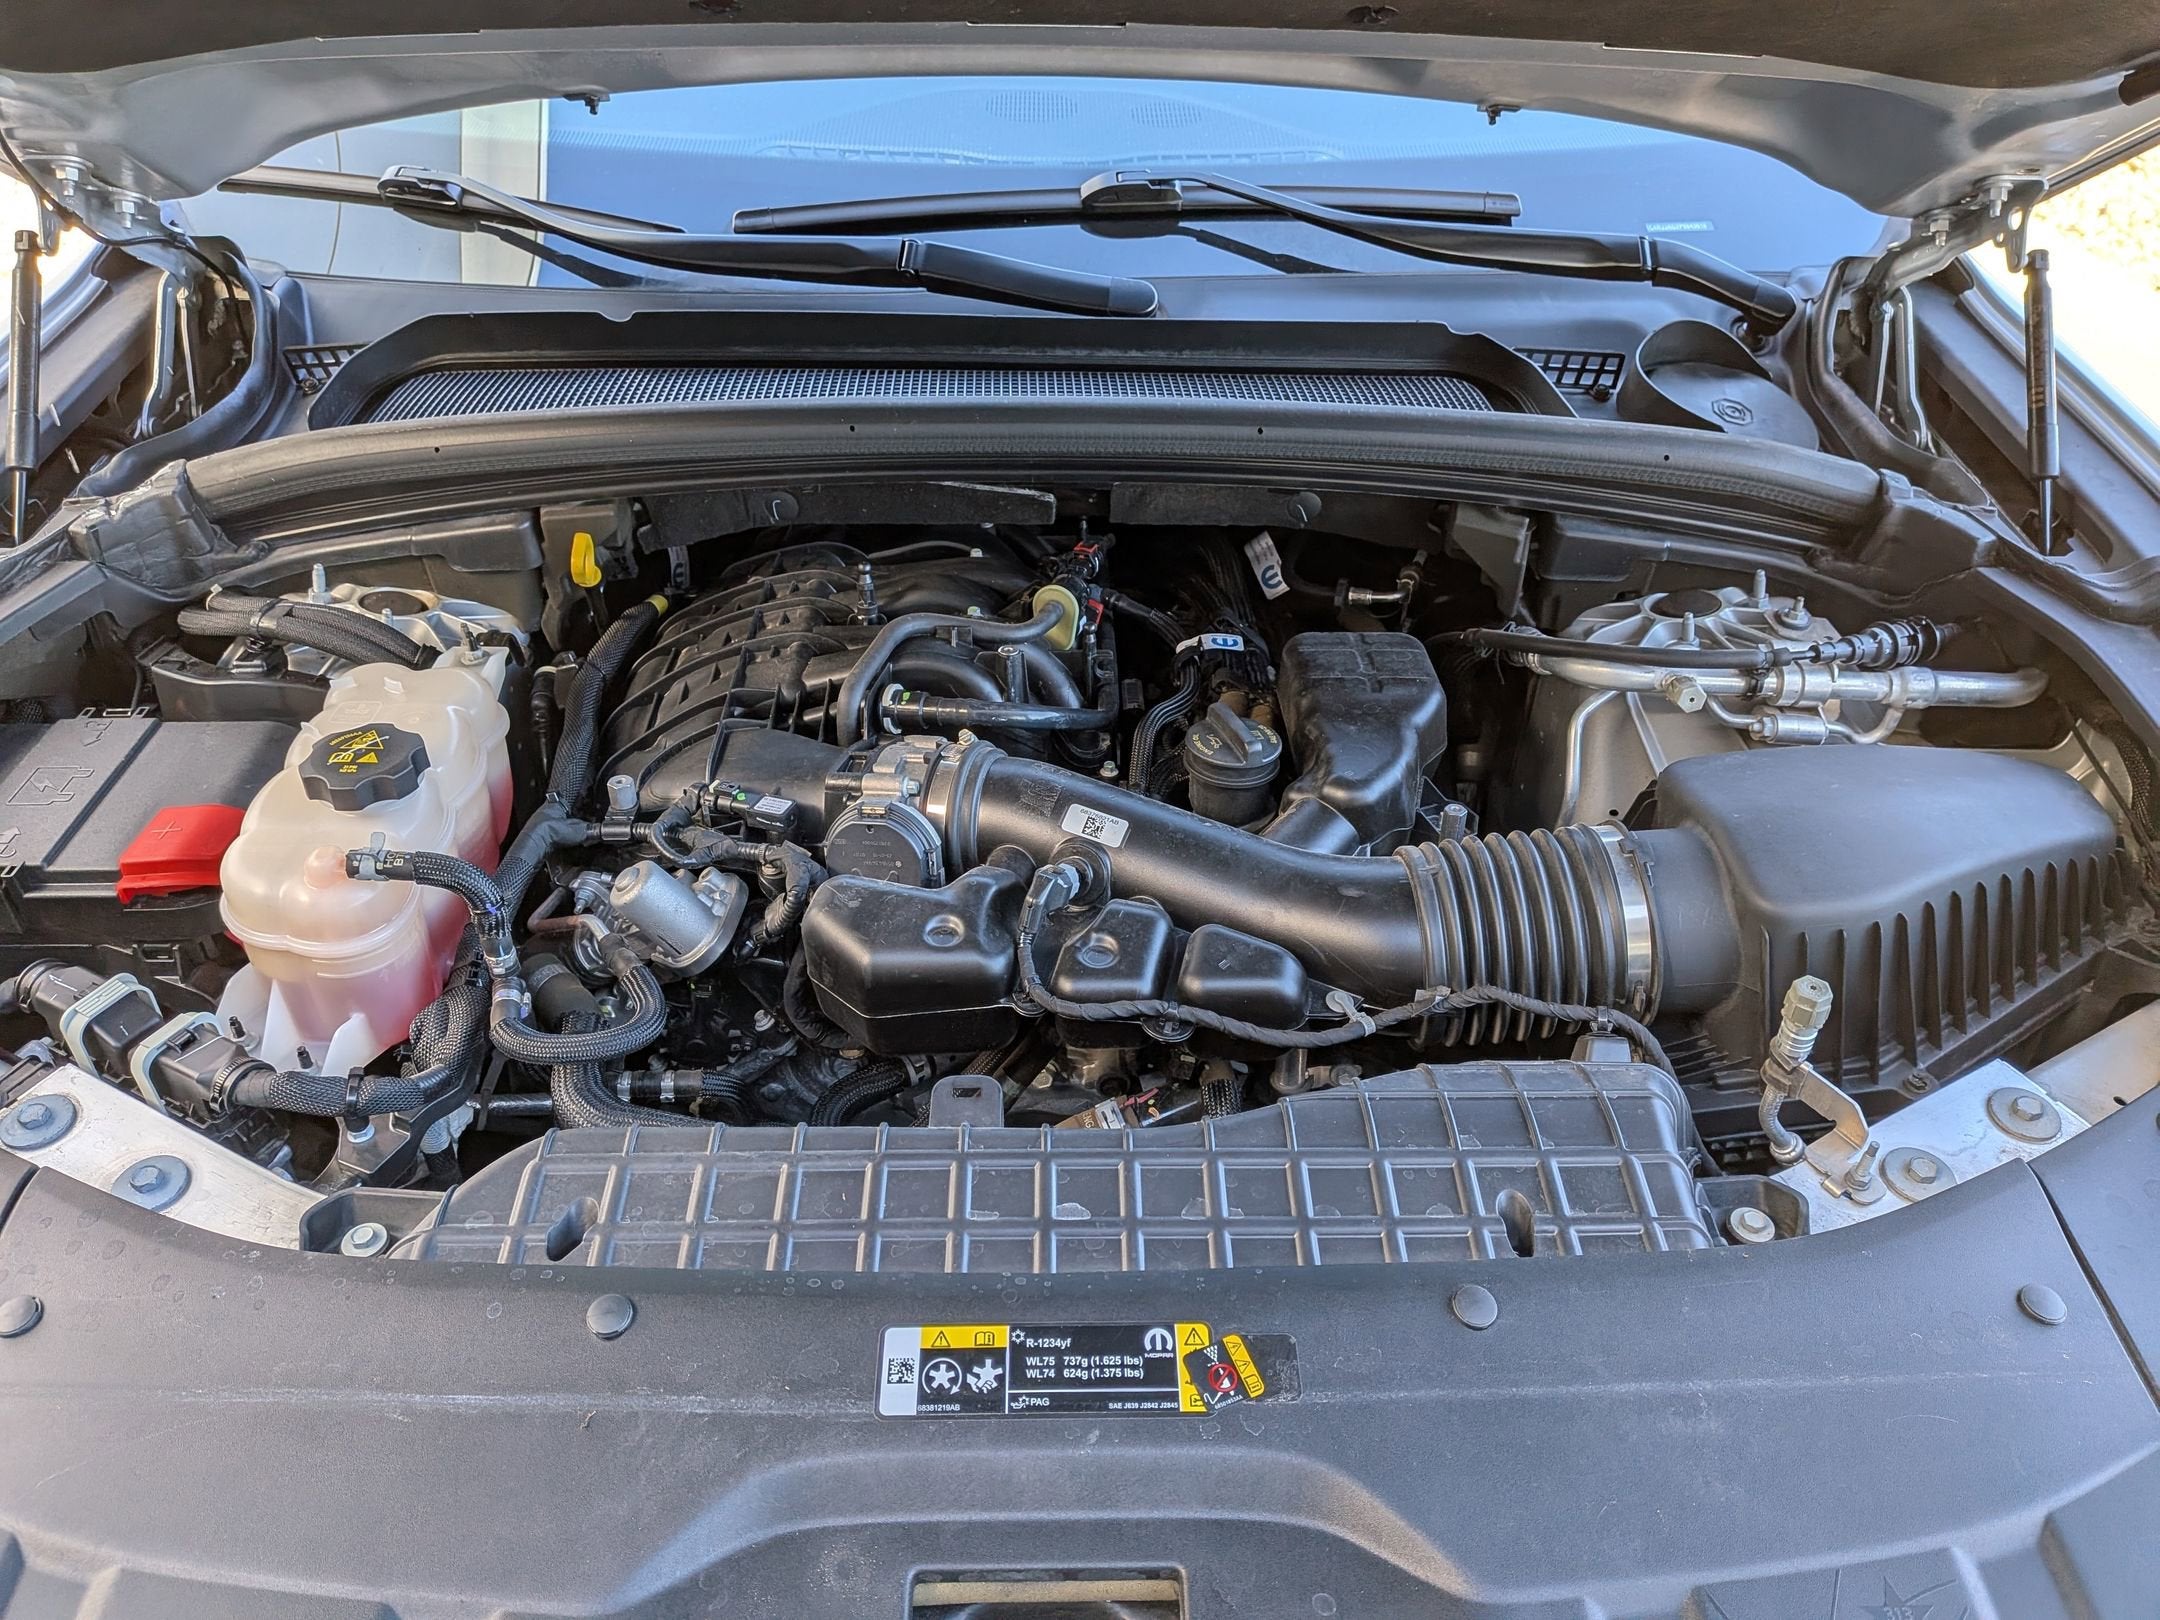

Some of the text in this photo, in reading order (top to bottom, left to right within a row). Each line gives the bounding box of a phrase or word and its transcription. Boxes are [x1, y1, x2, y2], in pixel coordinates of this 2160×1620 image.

[1026, 1337, 1072, 1350] R-1234yf
[1025, 1355, 1143, 1368] WL75 737g (1.625 lbs)
[1025, 1368, 1145, 1380] WL74 624g (1.375 lbs)
[1030, 1397, 1050, 1406] PAG
